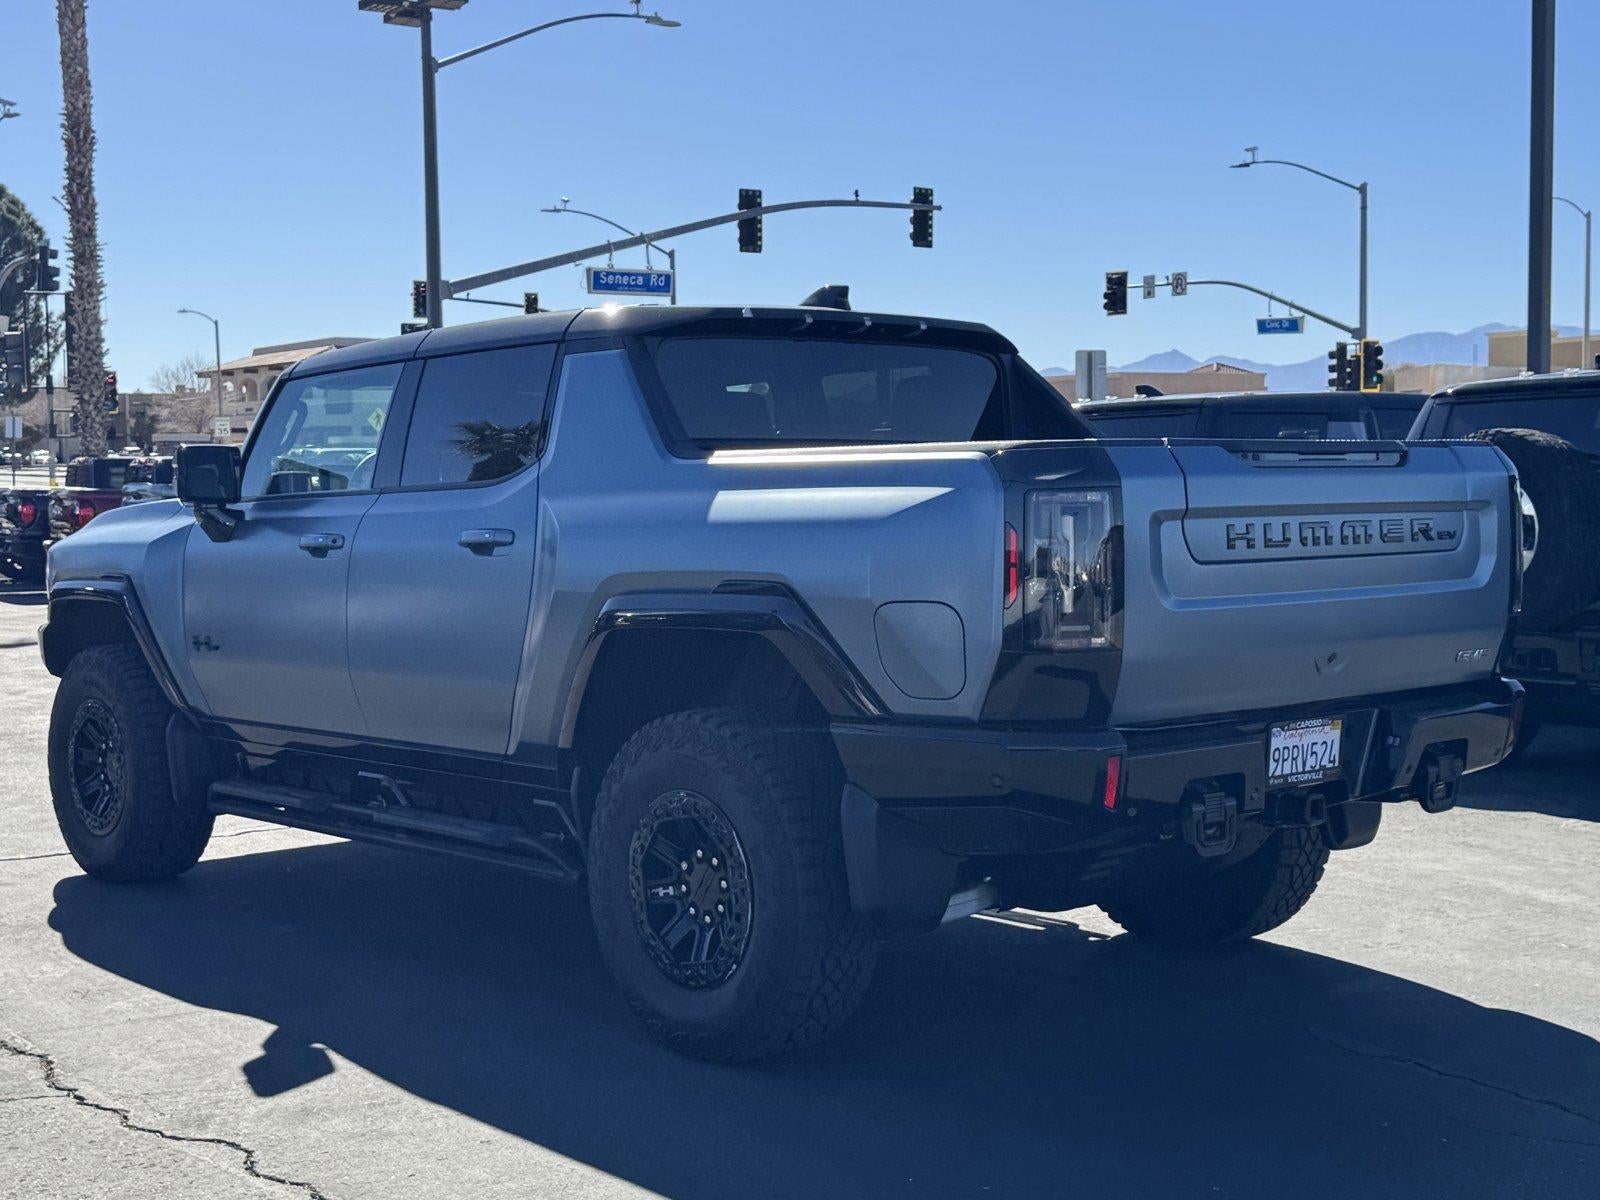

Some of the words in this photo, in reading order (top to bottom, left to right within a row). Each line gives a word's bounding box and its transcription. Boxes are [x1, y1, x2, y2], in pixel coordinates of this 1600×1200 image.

[600, 272, 643, 285] Seneca
[650, 274, 665, 286] Rd
[1226, 517, 1435, 549] HUMMER
[1272, 739, 1336, 776] 9PRV524
[1288, 771, 1323, 782] VICTORVILLE
